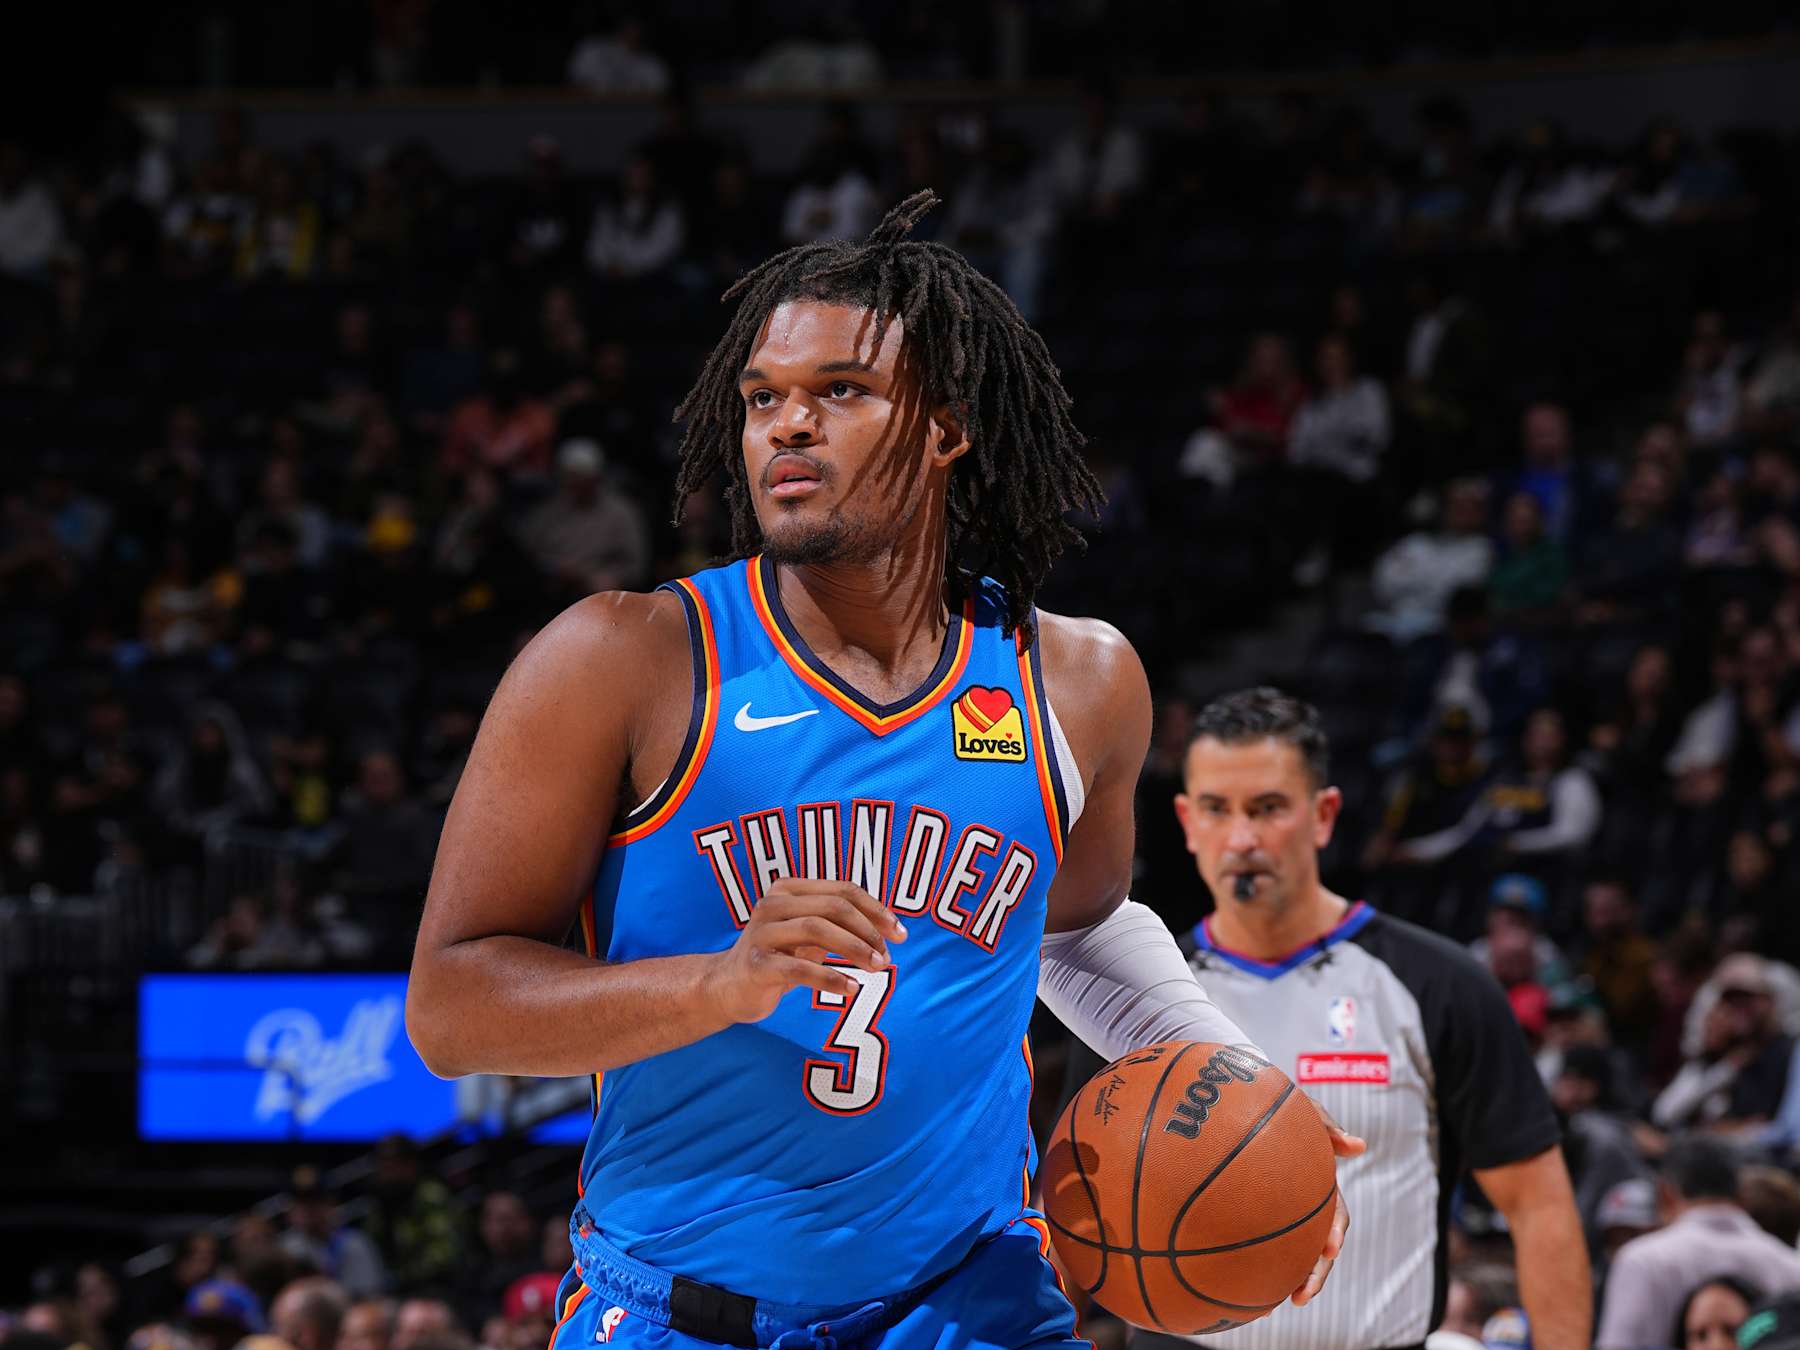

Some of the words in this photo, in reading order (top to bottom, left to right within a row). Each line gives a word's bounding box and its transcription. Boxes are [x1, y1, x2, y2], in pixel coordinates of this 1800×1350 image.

[692, 798, 1038, 954] THUNDER
[802, 956, 897, 1117] 3
[1163, 1045, 1271, 1140] ilson
